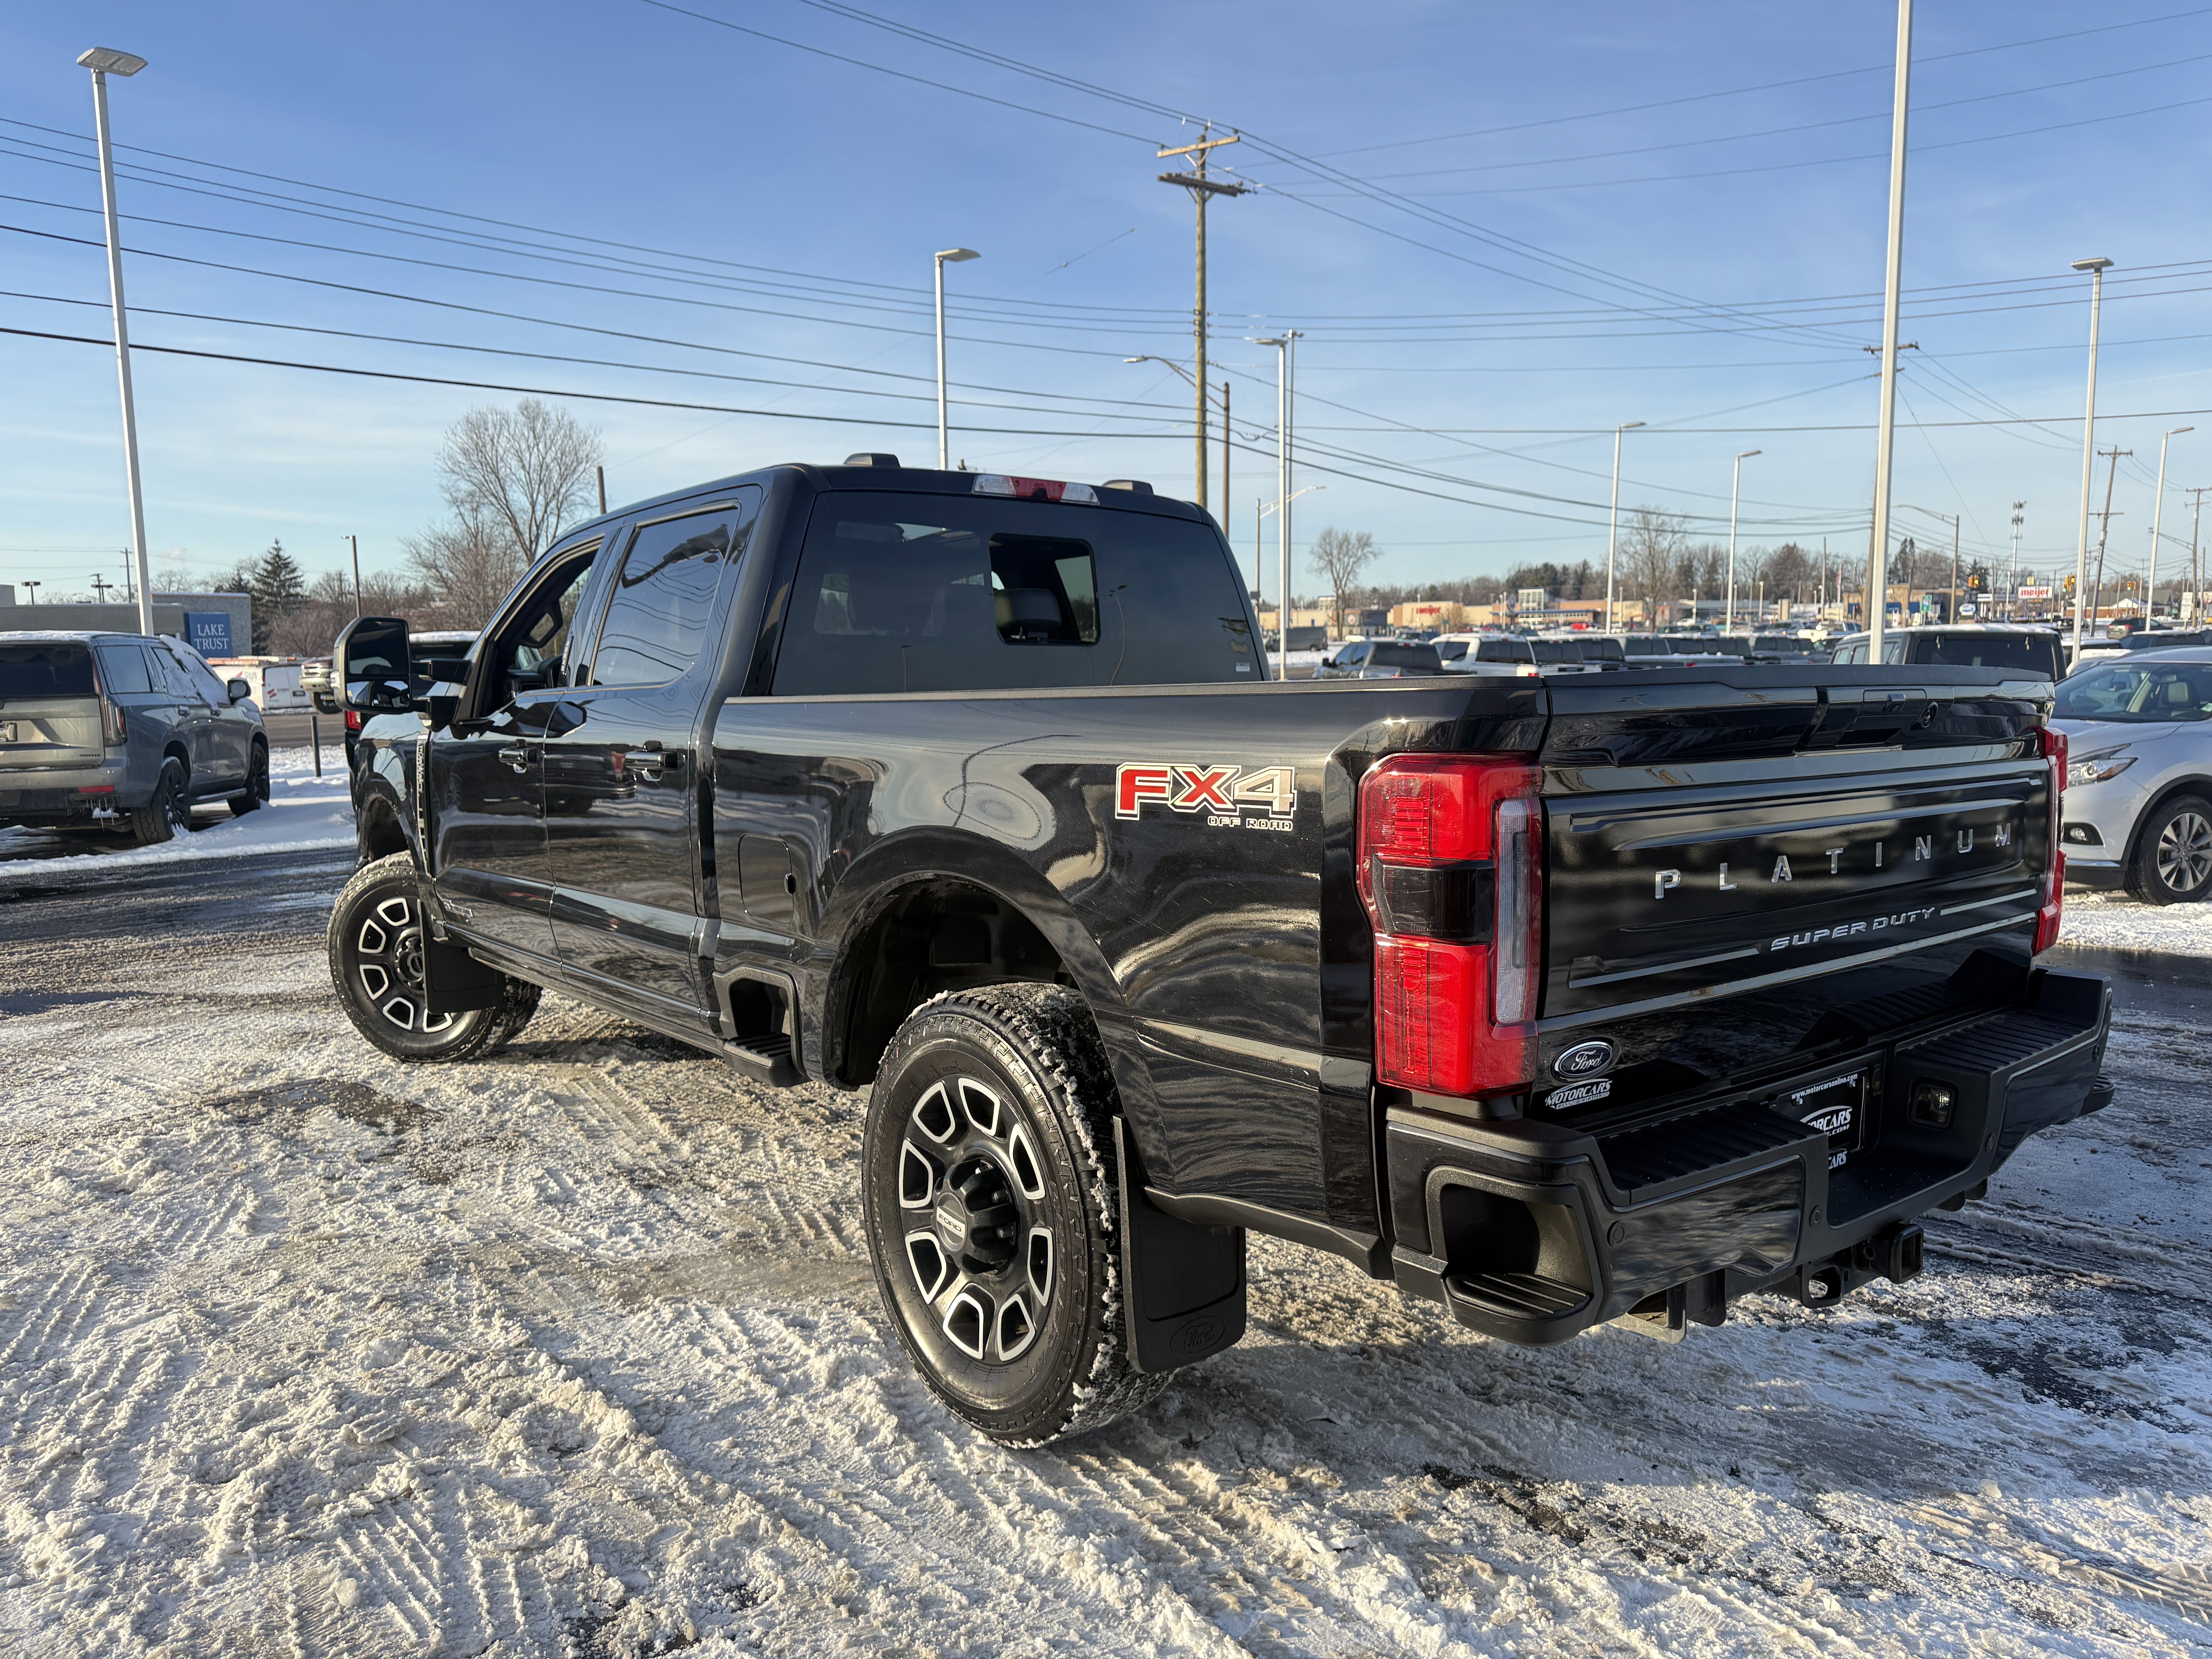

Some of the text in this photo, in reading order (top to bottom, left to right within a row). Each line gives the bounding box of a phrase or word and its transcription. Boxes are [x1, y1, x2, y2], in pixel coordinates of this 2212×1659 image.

[2021, 587, 2049, 597] meijer
[197, 624, 225, 636] LAKE
[194, 637, 228, 650] TRUST
[1115, 762, 1297, 821] FX4
[1207, 816, 1293, 831] OFF ROAD
[1655, 822, 2011, 900] PLATINUM
[1771, 907, 1936, 952] SUPER DUTY
[1571, 1049, 1603, 1070] Ford
[1545, 1080, 1613, 1106] MOTORCARS
[1791, 1073, 1858, 1099] www.motorcarsonline.com
[1808, 1108, 1853, 1132] ORCARS
[872, 1087, 894, 1278] BRIDGESTONE
[939, 1214, 961, 1232] FORD
